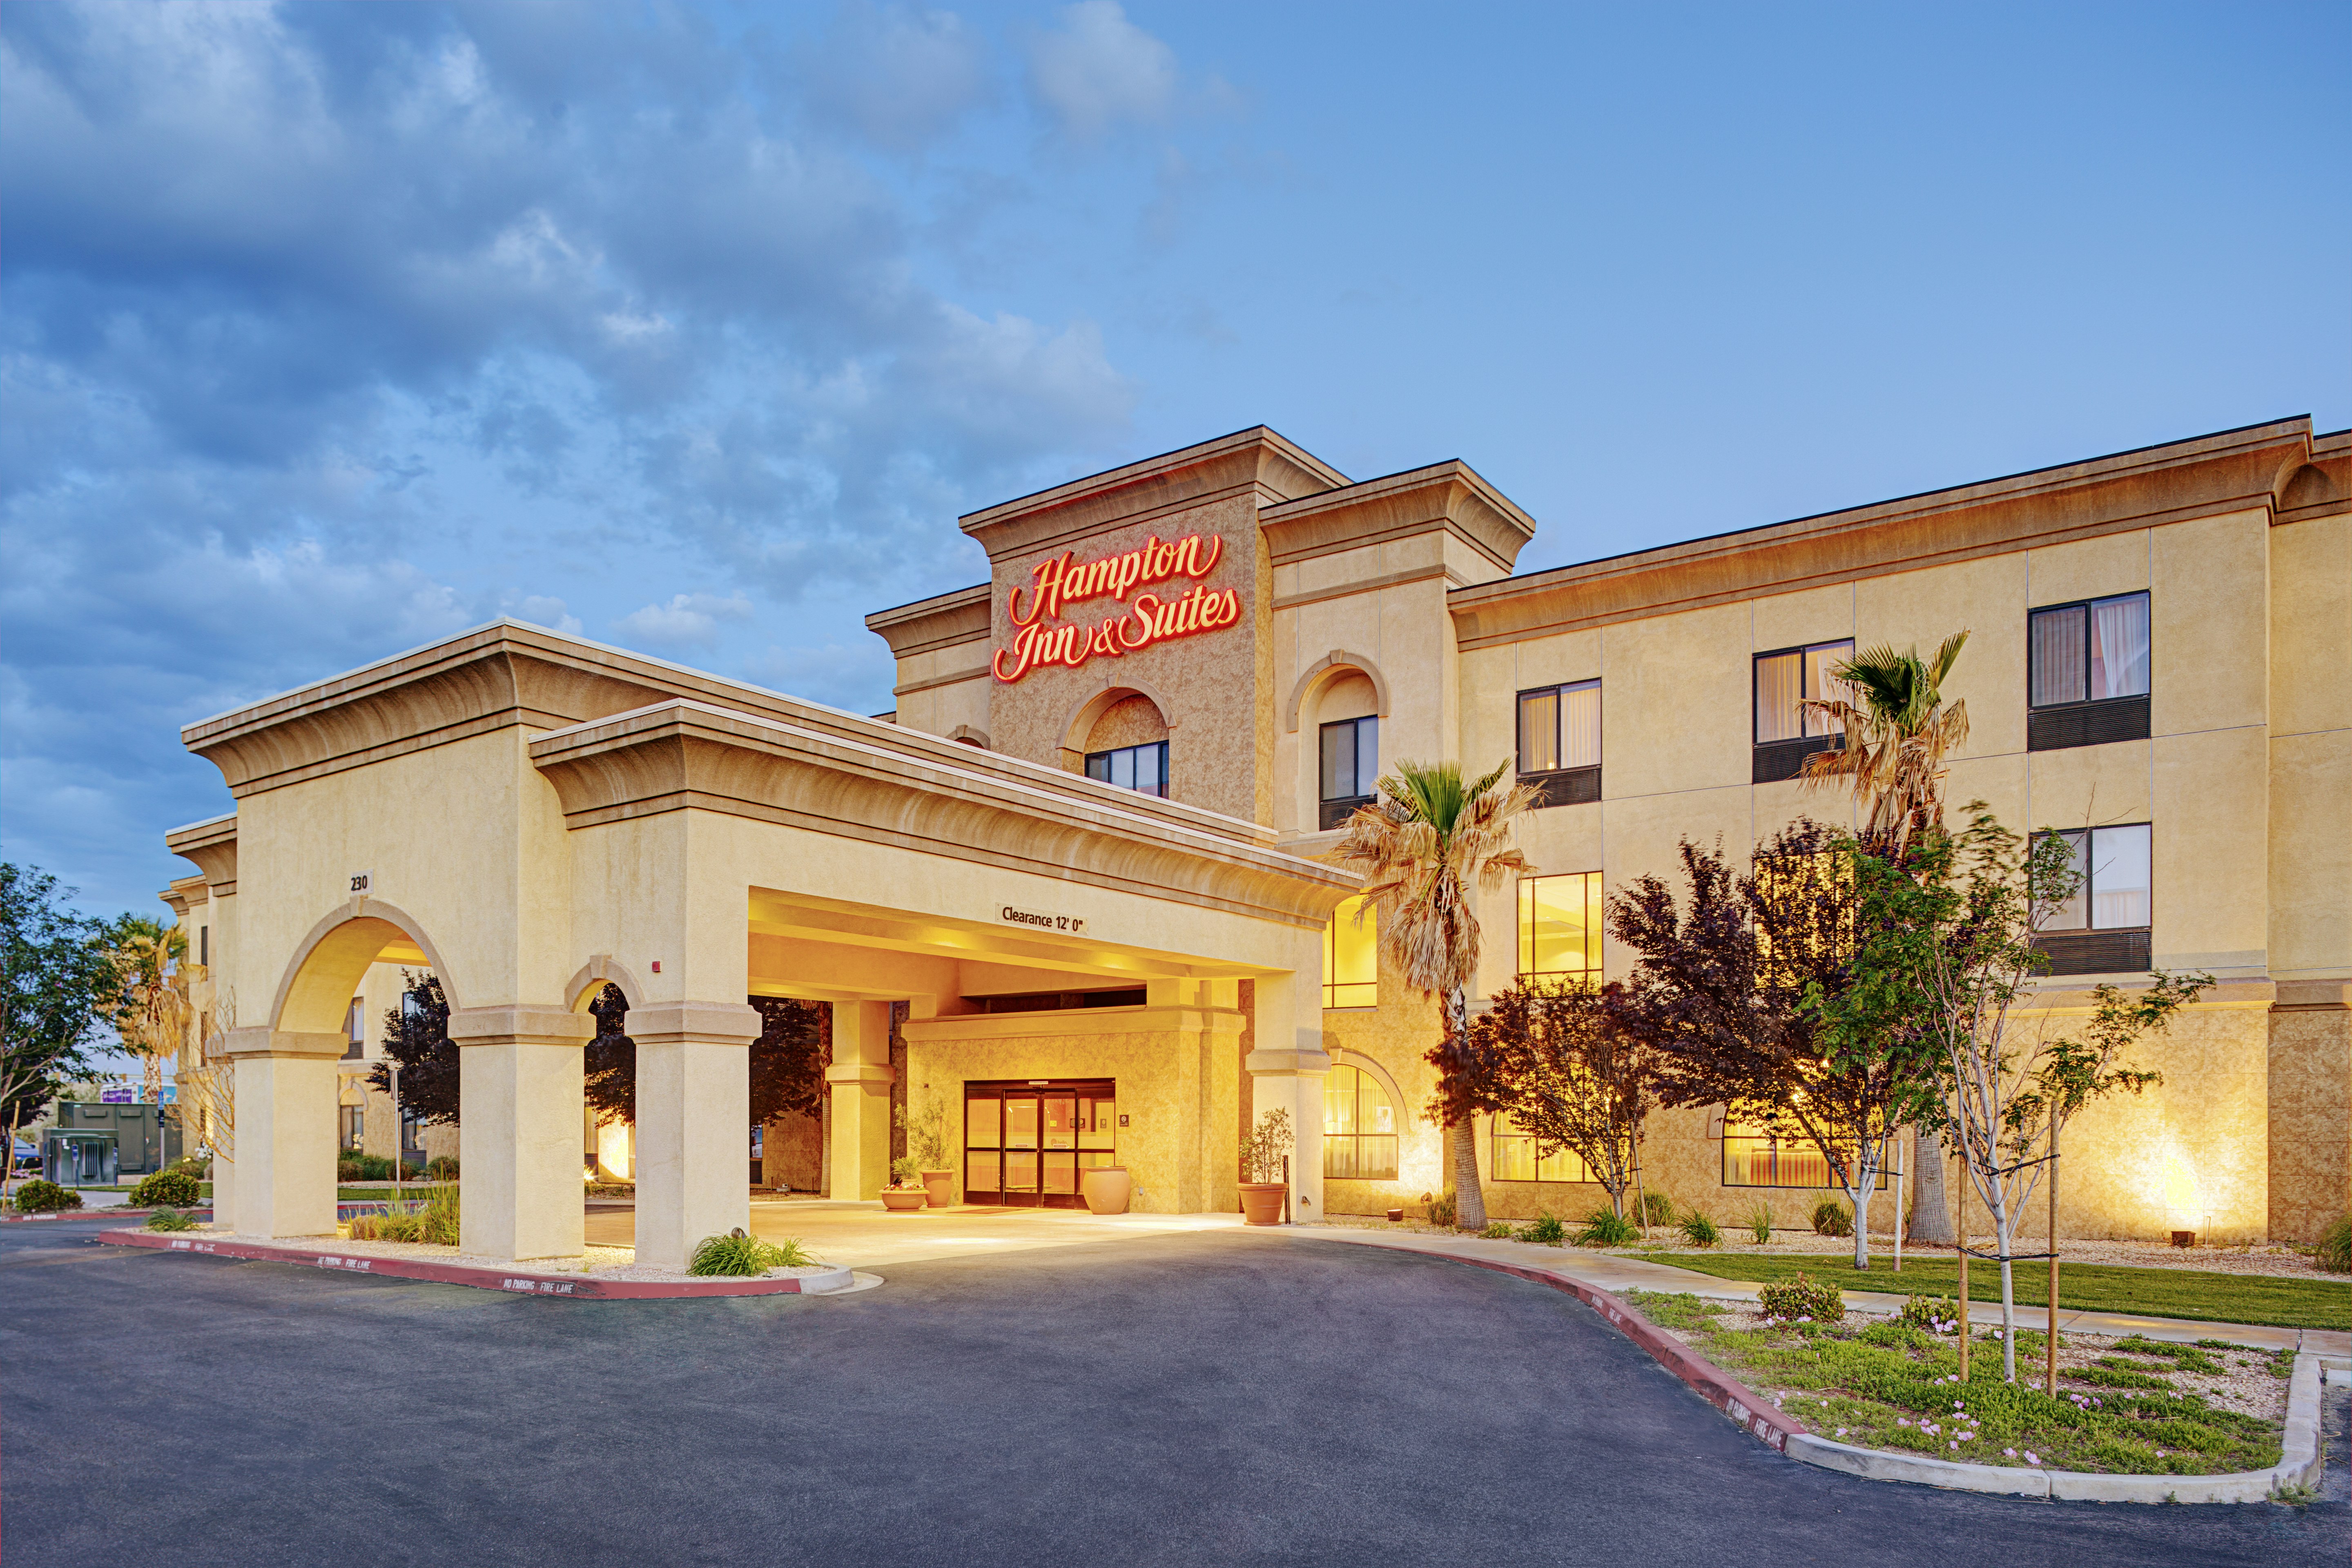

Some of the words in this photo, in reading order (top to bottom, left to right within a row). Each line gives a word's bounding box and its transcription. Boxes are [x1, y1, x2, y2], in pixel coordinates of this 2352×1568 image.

[1009, 535, 1223, 626] Hampton
[994, 622, 1095, 682] Inn
[1093, 618, 1123, 655] &
[1118, 585, 1240, 648] Suites
[351, 875, 367, 891] 230
[1003, 906, 1052, 927] Clearance
[1056, 916, 1069, 930] 12'
[324, 1256, 342, 1265] PARKING
[346, 1259, 357, 1268] FIRE
[357, 1261, 371, 1269] LANE
[504, 1278, 512, 1288] NO
[512, 1279, 535, 1290] PARKING
[540, 1282, 555, 1292] FIRE
[556, 1284, 573, 1294] LANE
[1726, 1396, 1734, 1414] NO
[1732, 1401, 1750, 1424] PARKING
[1754, 1418, 1768, 1438] FIRE
[1767, 1425, 1783, 1448] LANE
